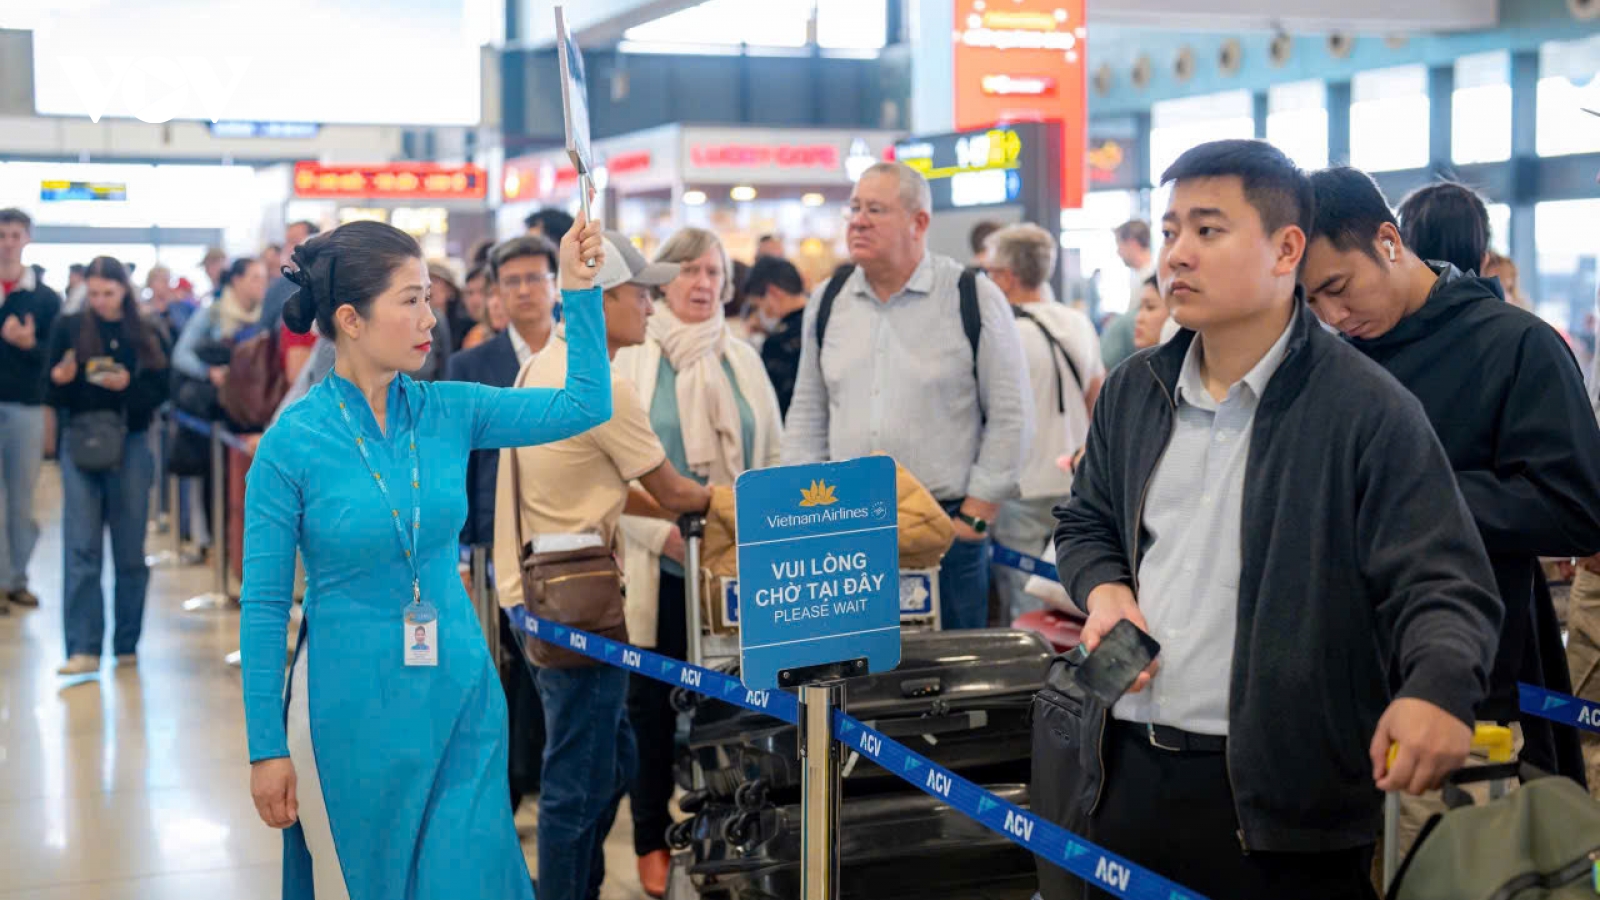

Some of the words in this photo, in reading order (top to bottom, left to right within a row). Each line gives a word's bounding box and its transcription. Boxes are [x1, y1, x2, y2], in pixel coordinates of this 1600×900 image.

[767, 512, 821, 529] Vietnam
[821, 507, 869, 523] Airlines
[771, 559, 805, 580] VUI
[811, 552, 867, 576] LÒNG
[755, 581, 802, 607] CHỜ
[806, 580, 839, 603] TẠI
[843, 572, 885, 596] ĐÂY
[774, 604, 830, 623] PLEASE
[833, 598, 869, 615] WAIT
[622, 649, 641, 669] ACV
[680, 667, 702, 688] ACV
[745, 689, 770, 709] ACV
[859, 730, 882, 757] ACV
[926, 768, 952, 797] ACV
[1003, 809, 1034, 842] ACV
[1095, 856, 1131, 891] ACV
